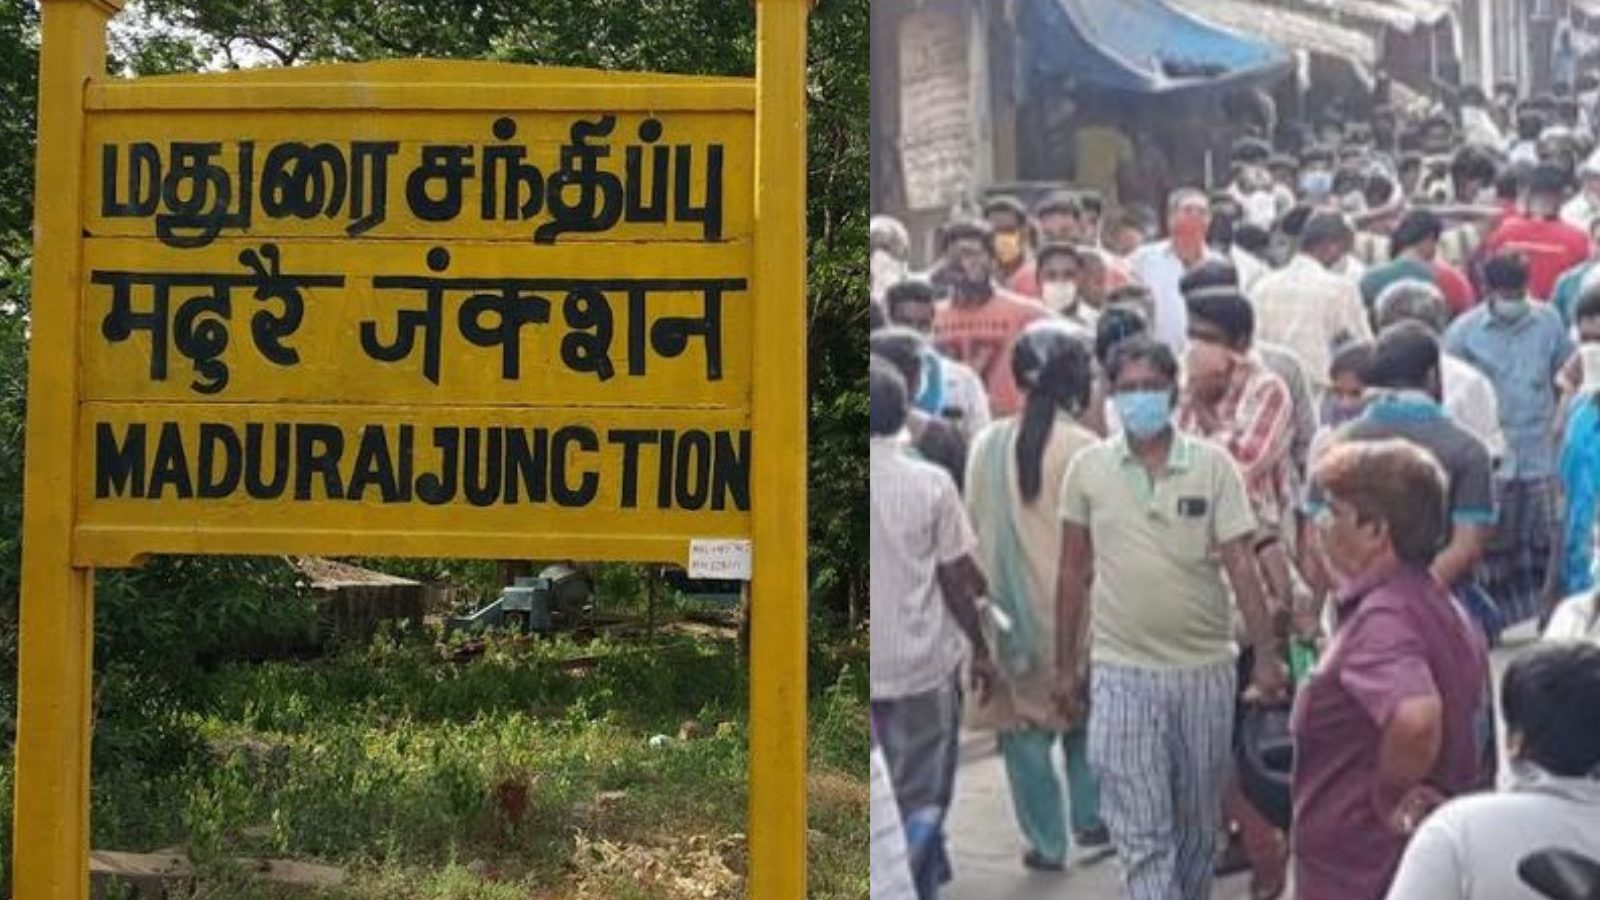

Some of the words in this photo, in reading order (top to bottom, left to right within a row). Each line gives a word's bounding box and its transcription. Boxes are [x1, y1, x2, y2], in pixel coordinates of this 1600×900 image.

[102, 141, 398, 248] மதுரை
[405, 117, 723, 245] சந்திப்பு
[91, 243, 345, 393] मदुरै
[360, 247, 748, 384] जंक्शन
[95, 422, 413, 500] MADURAI
[415, 425, 751, 511] JUNCTION
